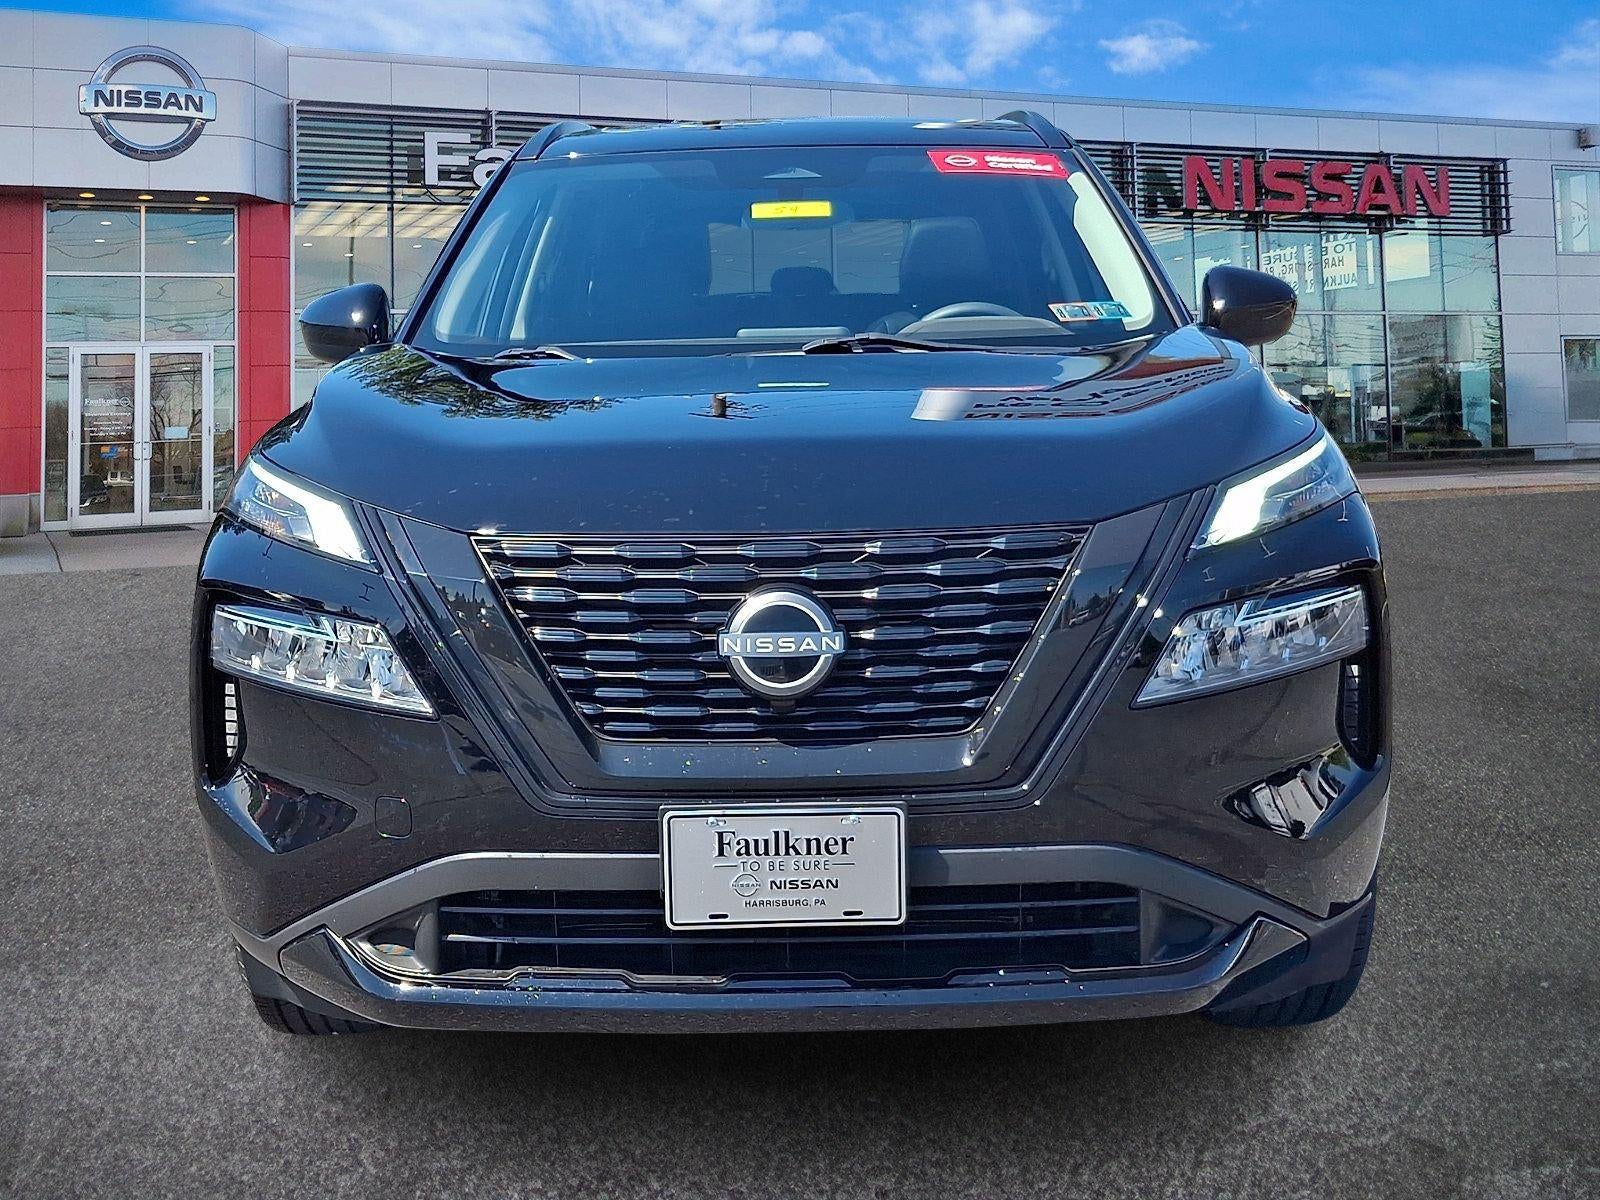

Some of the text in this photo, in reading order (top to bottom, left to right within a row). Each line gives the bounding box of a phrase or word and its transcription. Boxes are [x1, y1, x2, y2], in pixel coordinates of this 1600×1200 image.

[93, 89, 204, 113] NISSAN
[1182, 155, 1451, 217] NISSAN
[723, 636, 840, 653] NISSAN
[714, 830, 855, 858] Faulkner
[740, 859, 831, 872] TO BE SURE
[769, 878, 839, 890] NISSAN
[744, 898, 826, 908] HARRISBURG, PA
